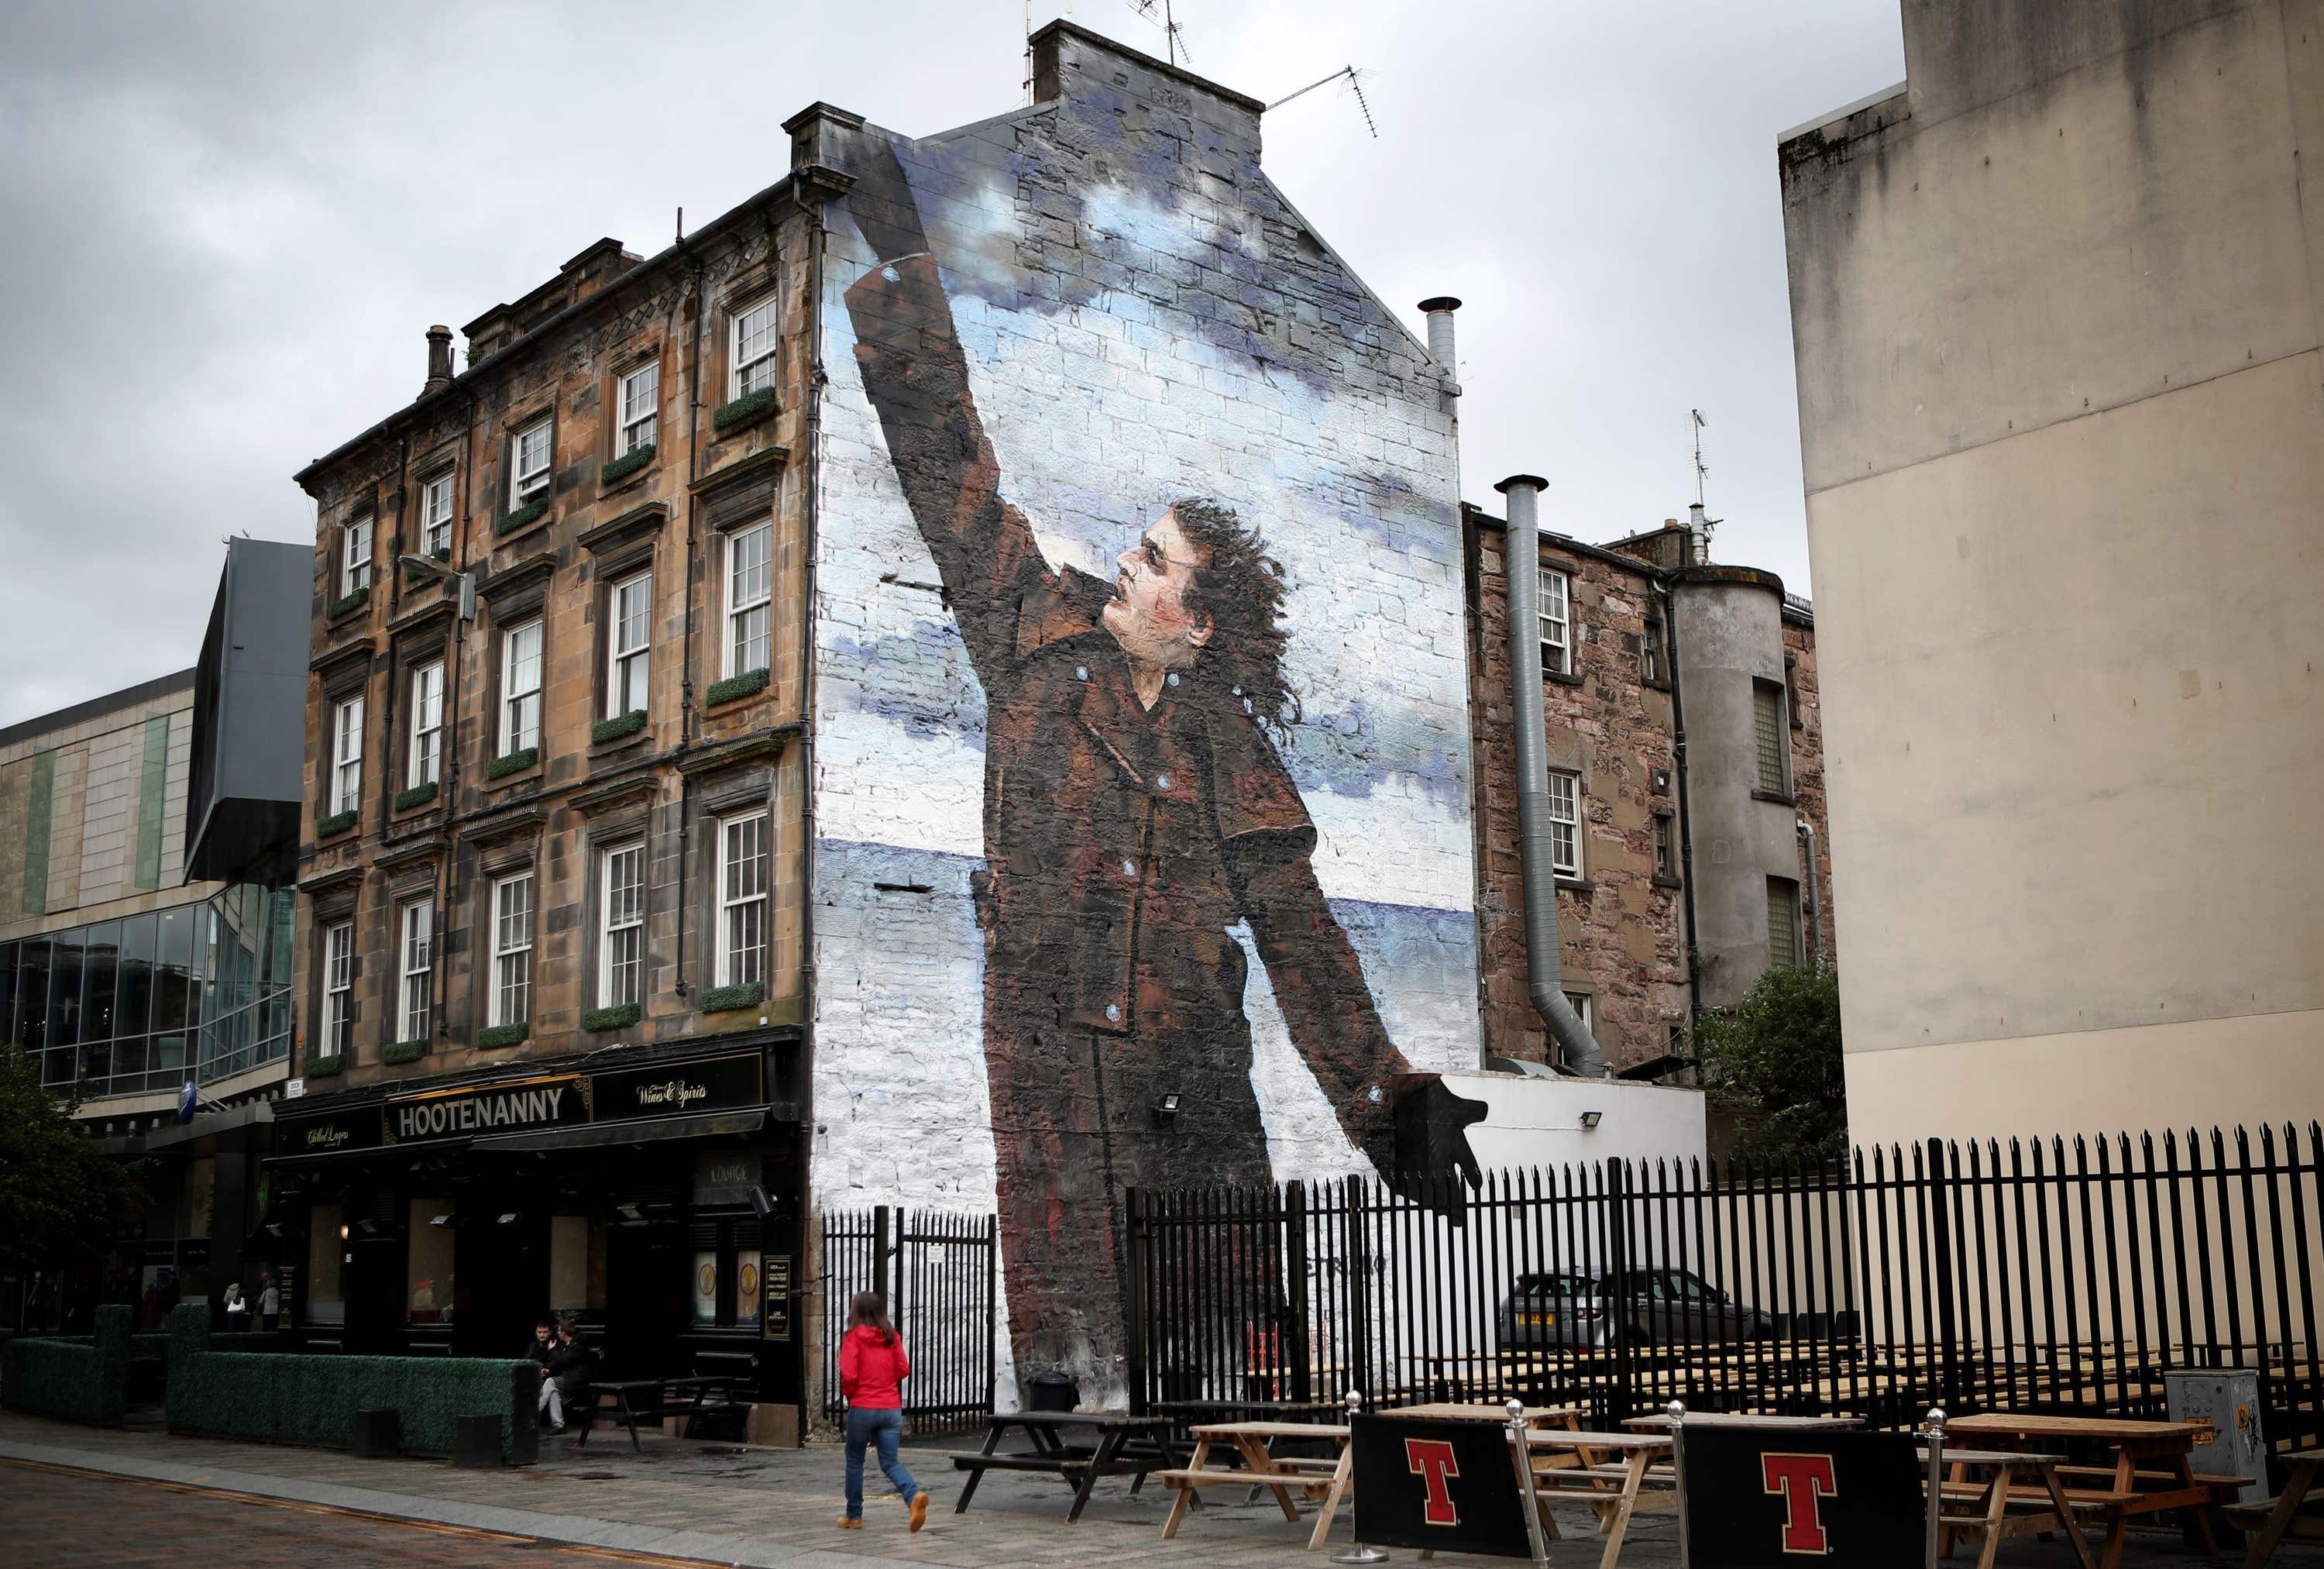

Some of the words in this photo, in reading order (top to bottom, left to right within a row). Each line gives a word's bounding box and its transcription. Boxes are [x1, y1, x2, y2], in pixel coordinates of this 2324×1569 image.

[400, 1088, 564, 1137] HOOTENANNY
[637, 1085, 664, 1104] Wines
[664, 1082, 676, 1101] &
[676, 1080, 708, 1108] Spirits
[1404, 1437, 1459, 1526] T
[1760, 1452, 1838, 1555] T
